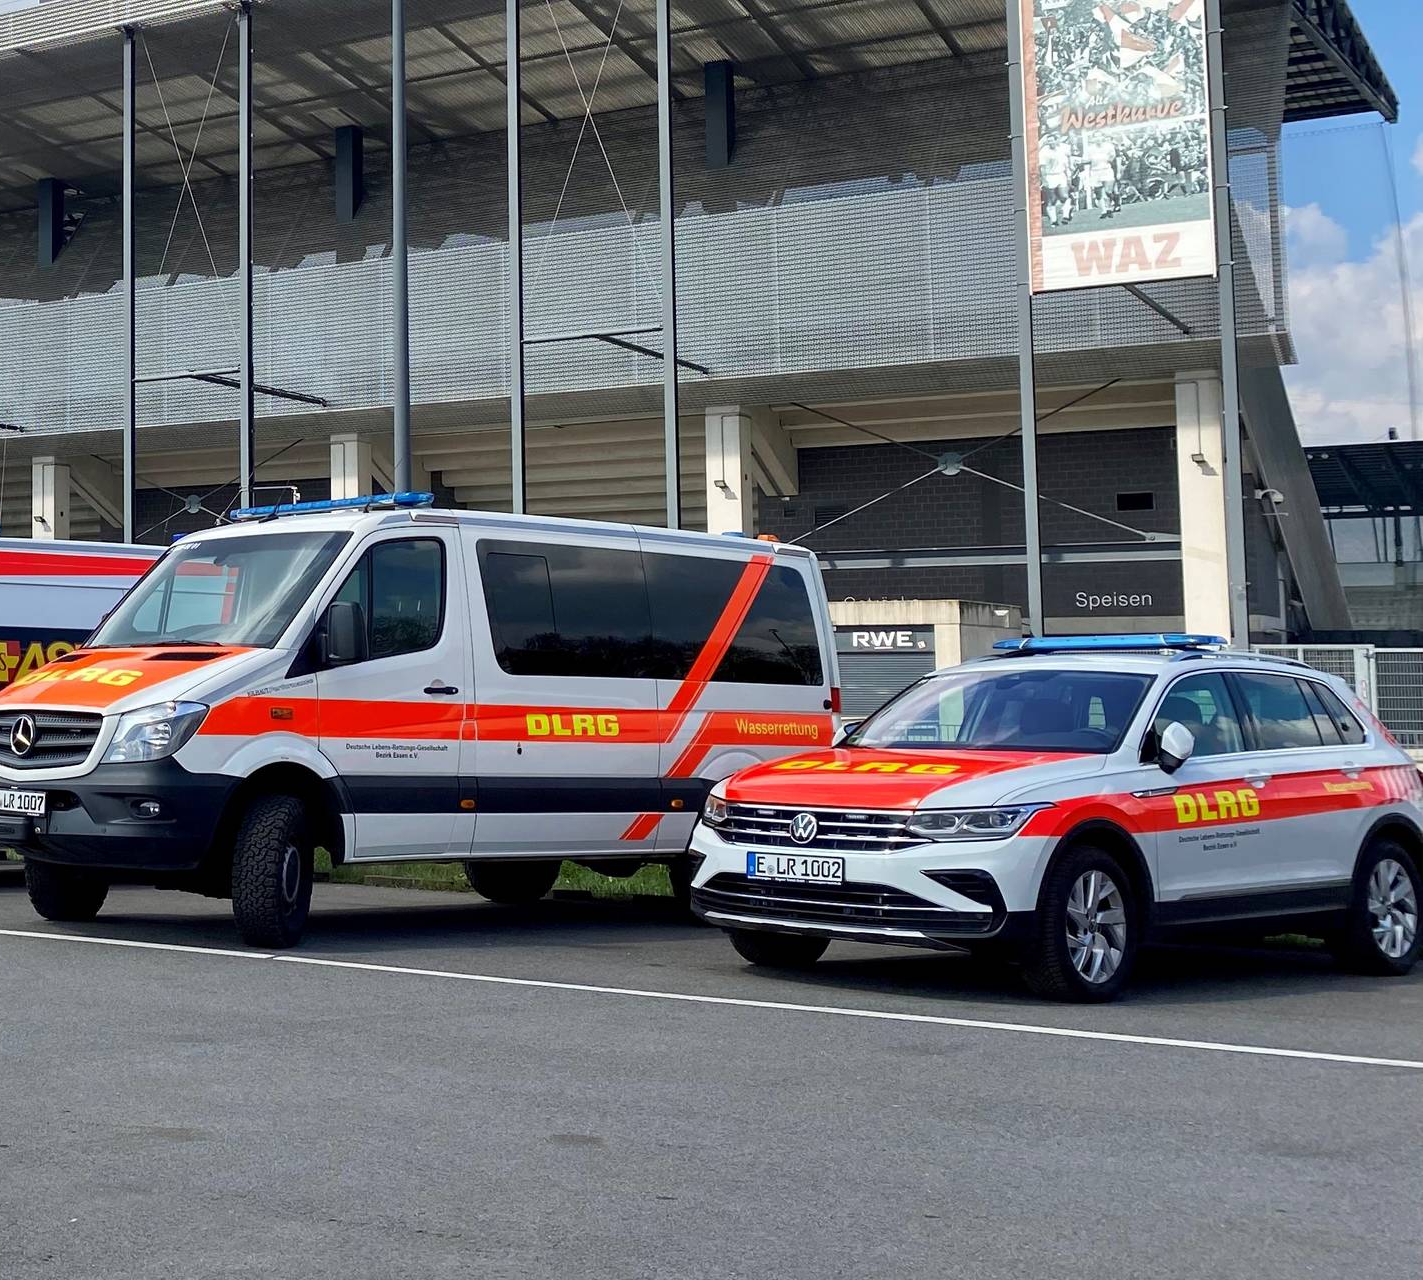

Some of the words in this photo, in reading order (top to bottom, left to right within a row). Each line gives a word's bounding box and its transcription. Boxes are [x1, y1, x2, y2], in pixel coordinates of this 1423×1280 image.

[1060, 100, 1183, 134] Westkurve
[1071, 232, 1182, 277] WAZ
[1075, 591, 1153, 611] Speisen
[852, 630, 914, 648] RWE
[13, 667, 143, 687] DLRG
[526, 713, 620, 737] DLRG
[735, 718, 819, 740] Wasserrettung
[773, 761, 962, 775] DLRG
[17, 794, 45, 812] 1007
[1173, 788, 1261, 823] DLRG
[756, 857, 766, 873] E
[776, 857, 796, 876] LR
[801, 859, 841, 879] 1002
